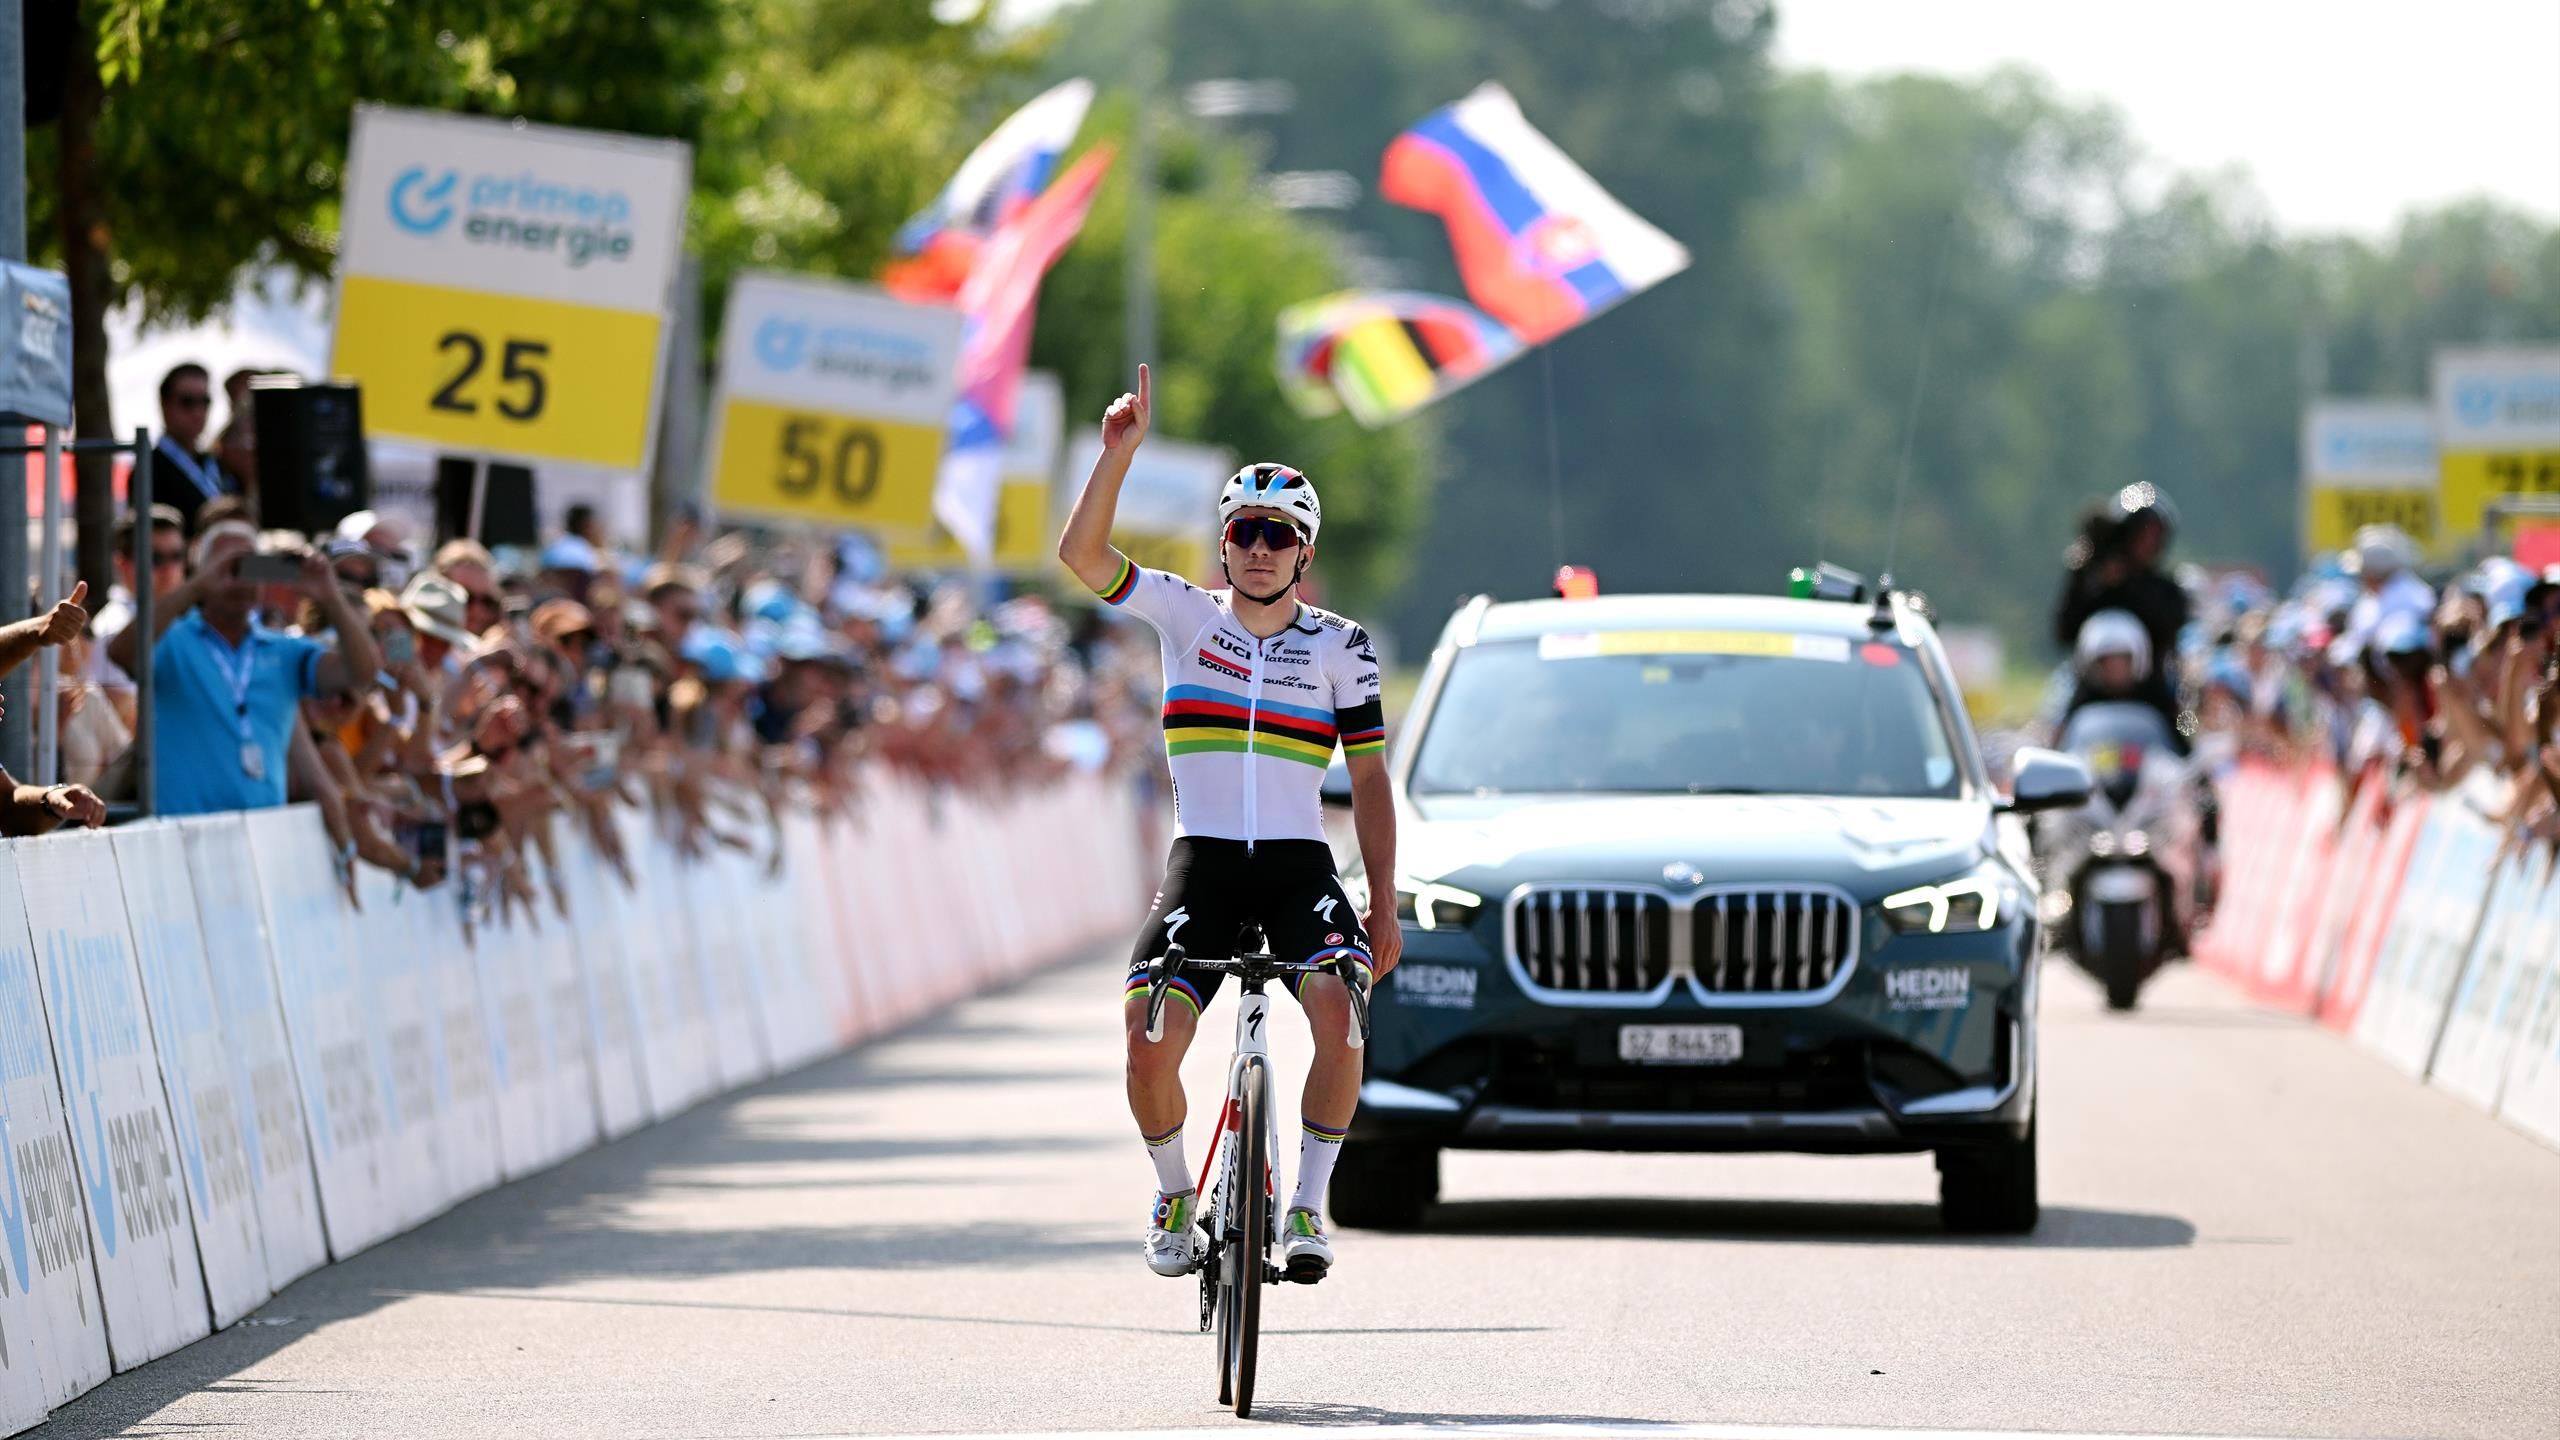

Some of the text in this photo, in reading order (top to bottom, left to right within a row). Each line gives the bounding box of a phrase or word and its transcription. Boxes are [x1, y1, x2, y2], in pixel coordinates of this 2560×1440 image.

[465, 213, 633, 268] energie
[430, 331, 551, 422] 25
[776, 415, 886, 507] 50
[1218, 637, 1252, 660] UCI
[1264, 654, 1311, 665] latexco
[1283, 648, 1311, 656] Ekopak
[1198, 657, 1252, 683] SOUDAL
[1262, 678, 1318, 691] QUICK-STEP
[1393, 965, 1477, 993] HEDIN
[1885, 966, 1971, 998] HEDIN
[107, 1063, 179, 1290] energie
[16, 1083, 86, 1328] energie
